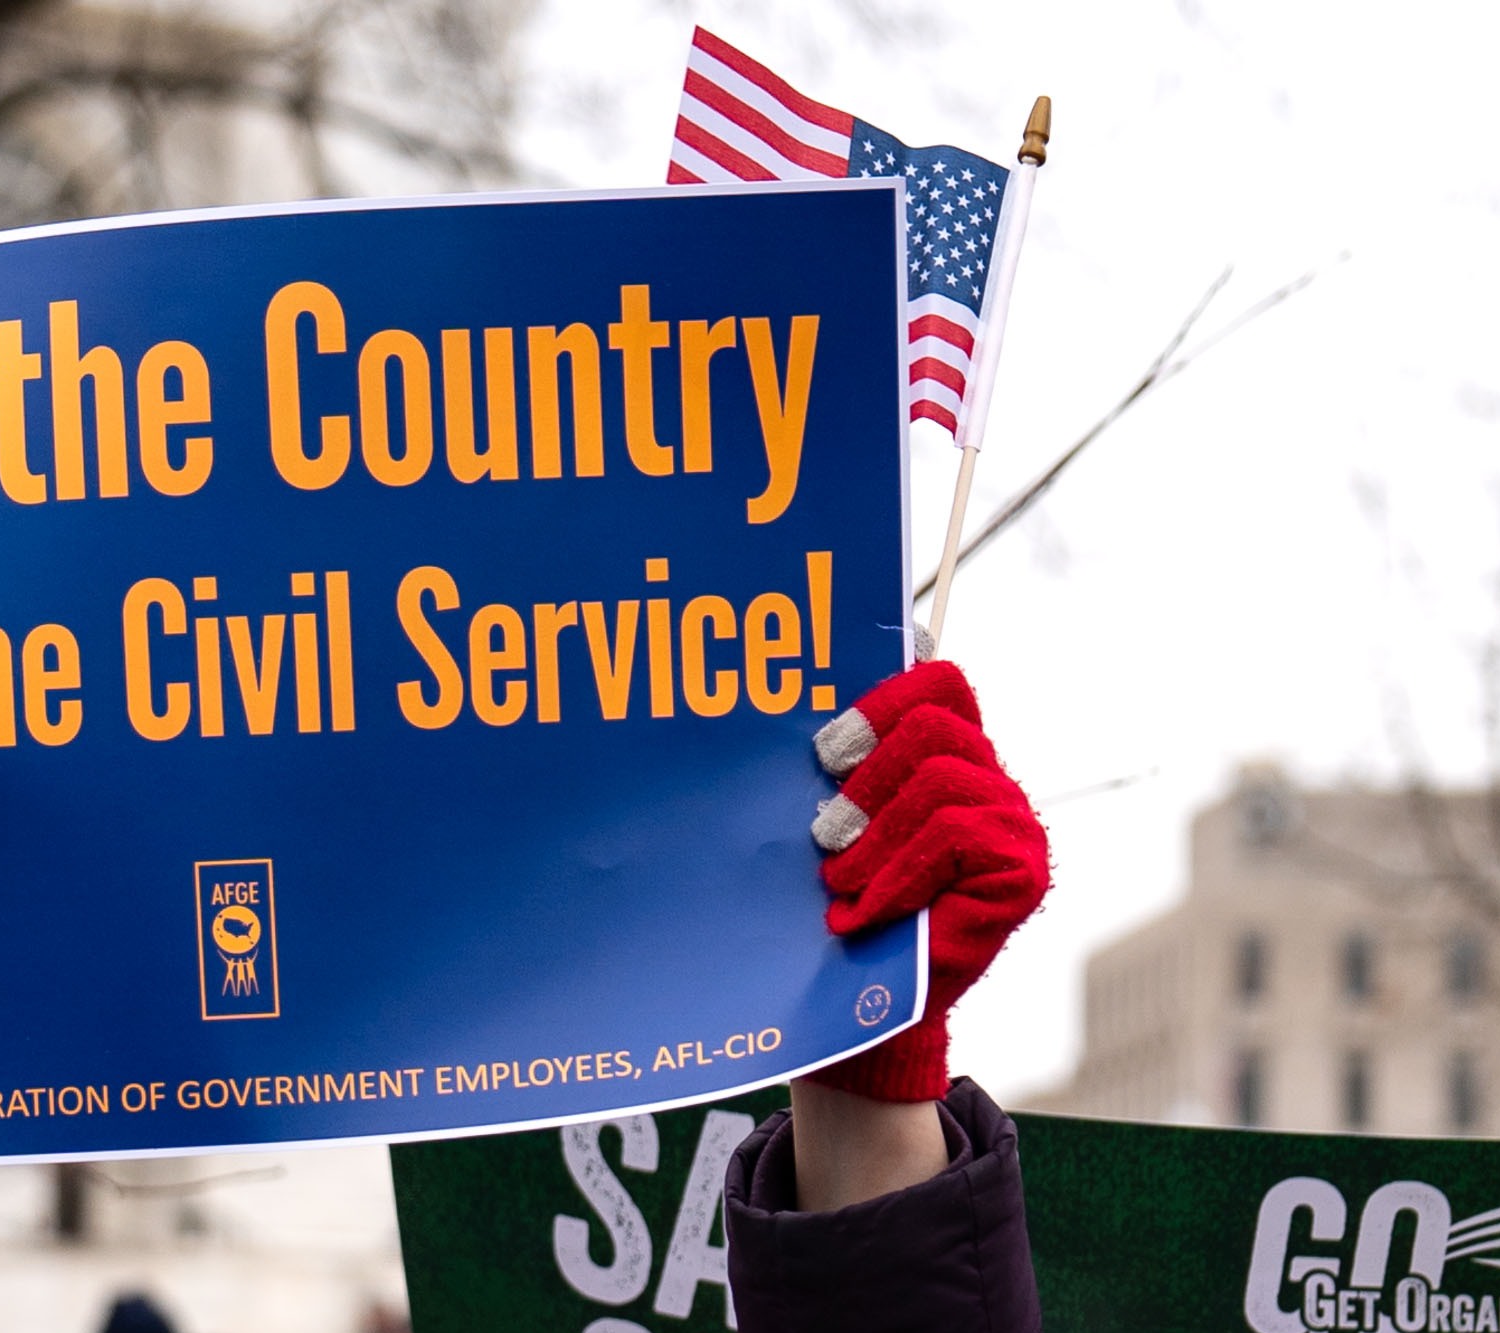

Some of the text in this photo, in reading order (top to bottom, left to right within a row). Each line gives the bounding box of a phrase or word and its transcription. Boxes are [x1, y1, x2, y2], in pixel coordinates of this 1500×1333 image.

[265, 281, 819, 524] Country
[123, 571, 355, 741] Civil
[397, 551, 836, 729] Service!
[211, 881, 261, 906] AFGE
[121, 1081, 166, 1112] OF
[177, 1067, 425, 1110] GOVERNMENT
[435, 1049, 644, 1094] EMPLOYEES,
[651, 1027, 783, 1072] AFL-CIO
